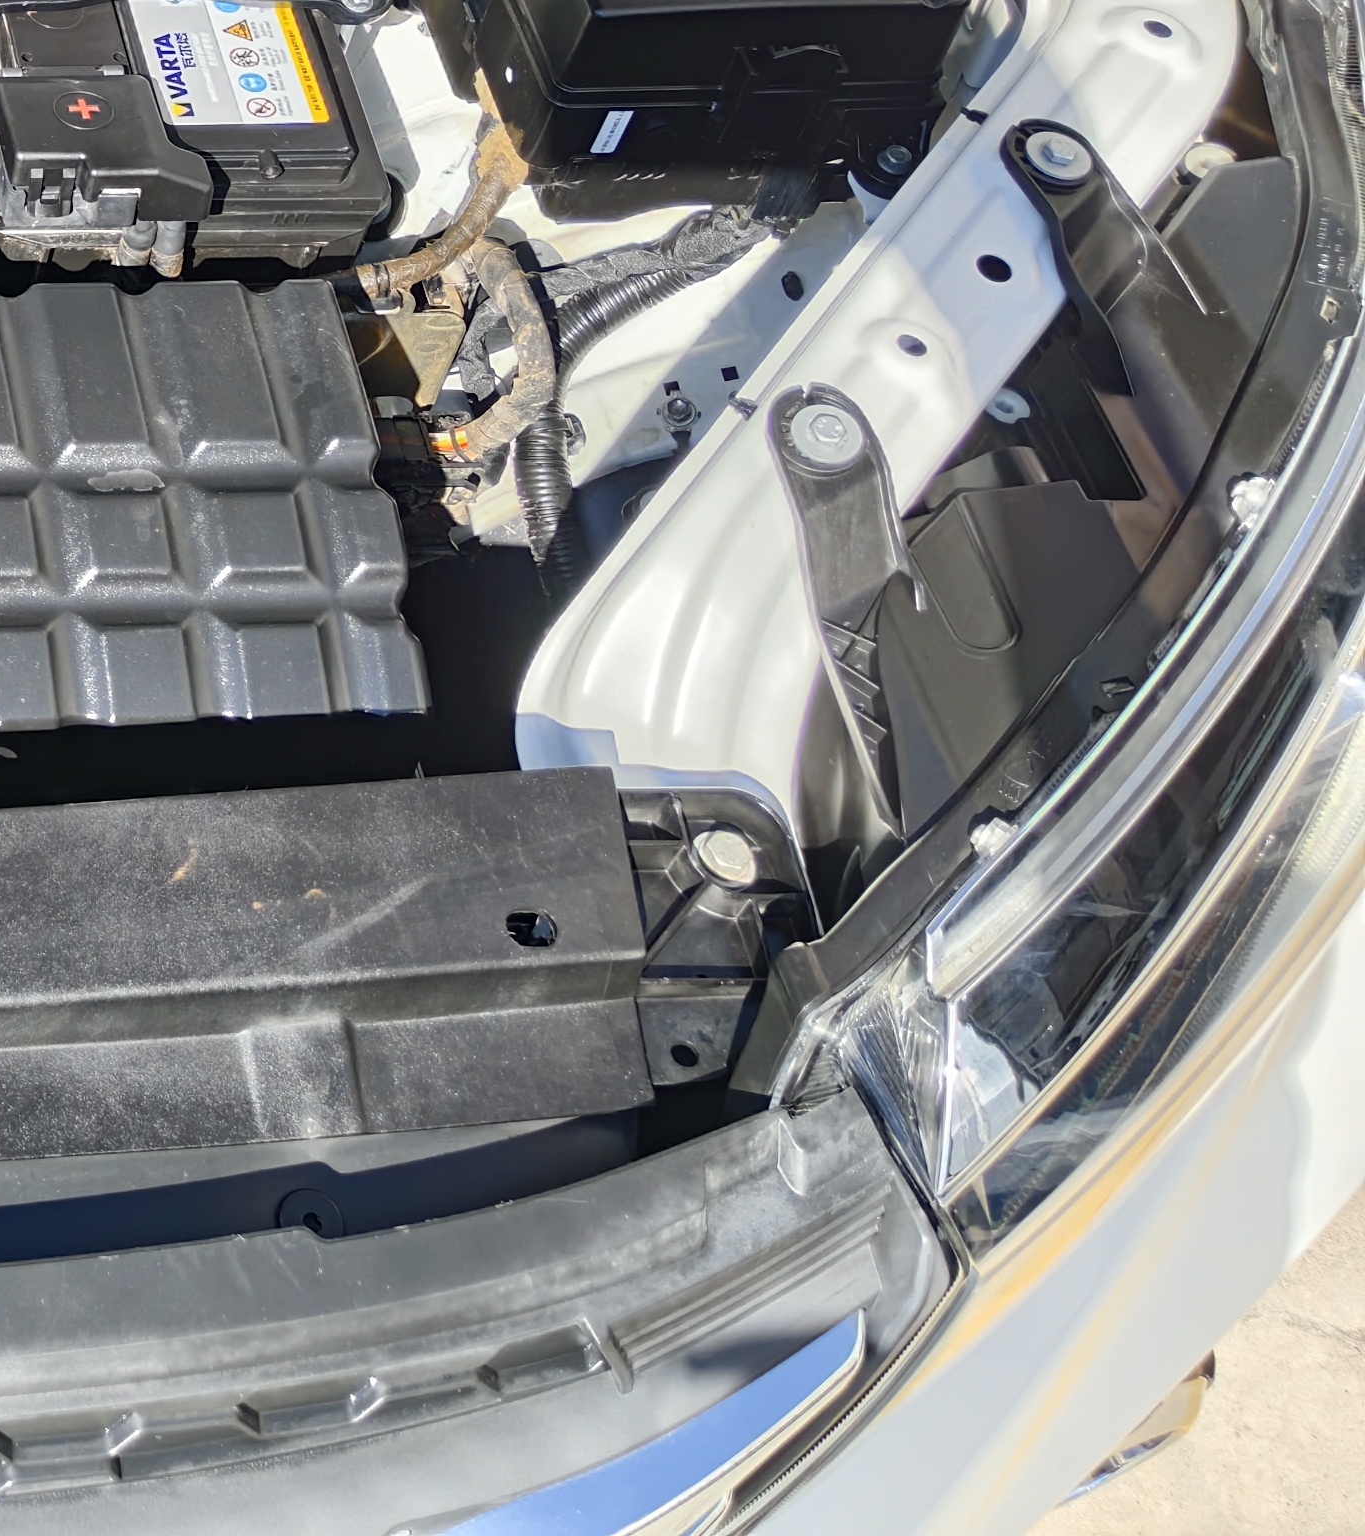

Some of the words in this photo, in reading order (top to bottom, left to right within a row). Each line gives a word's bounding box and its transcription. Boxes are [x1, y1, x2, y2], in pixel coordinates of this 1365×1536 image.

[153, 33, 189, 99] VARTA
[175, 32, 196, 68] 瓦尔塔
